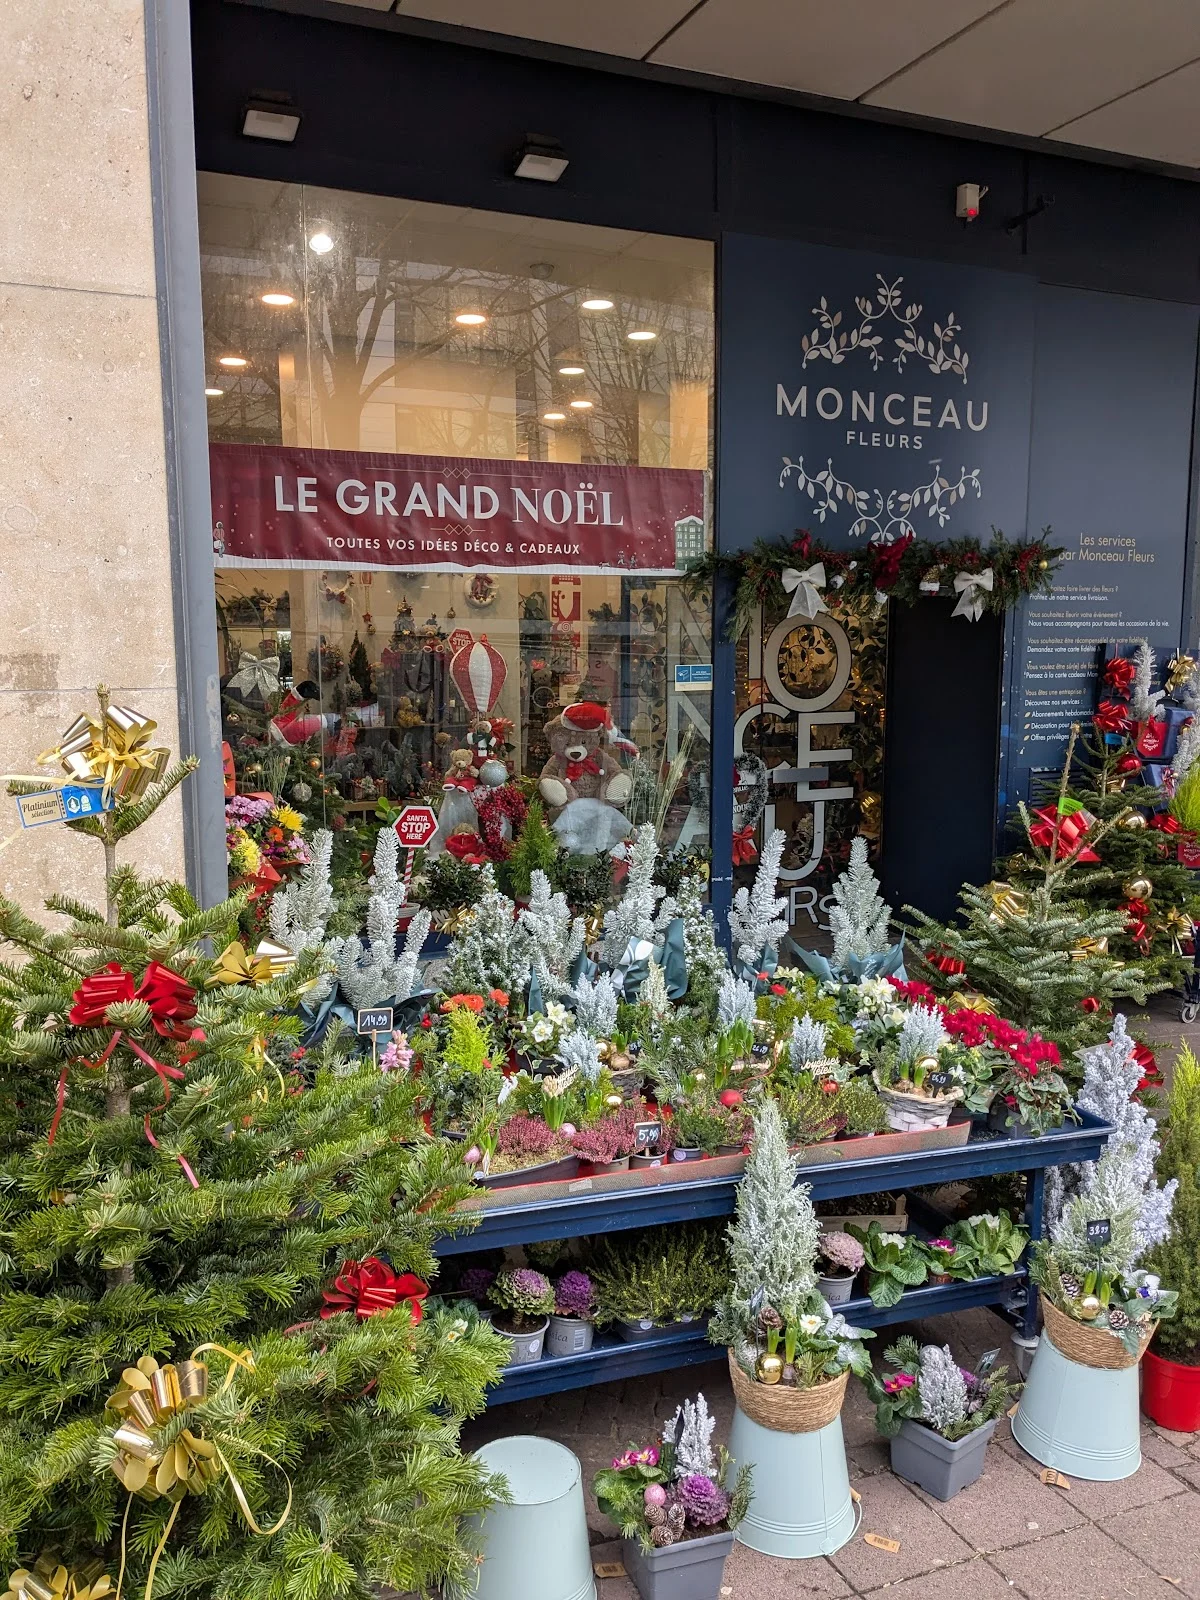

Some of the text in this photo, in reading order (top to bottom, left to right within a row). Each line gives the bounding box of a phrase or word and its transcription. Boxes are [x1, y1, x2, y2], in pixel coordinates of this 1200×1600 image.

[776, 383, 988, 432] MONCEAU
[846, 430, 923, 450] FLEURS
[274, 475, 624, 526] LE GRAND NOËL
[1080, 532, 1136, 547] Les services
[326, 536, 580, 555] TOUTES VOS IDÉES DÉCO & CADEAUX
[1058, 548, 1155, 562] par Monceau Fleurs
[1109, 636, 1116, 644] de
[1027, 645, 1054, 653] Demandez
[1039, 662, 1056, 670] voulez
[1068, 670, 1086, 678] cadeau
[1024, 699, 1051, 707] Découvrez
[1031, 710, 1065, 718] Abonnements
[1031, 722, 1058, 730] Décoration
[22, 800, 58, 813] Platinium
[406, 814, 428, 822] SANTA
[400, 821, 431, 833] STOP
[405, 832, 423, 840] HERE
